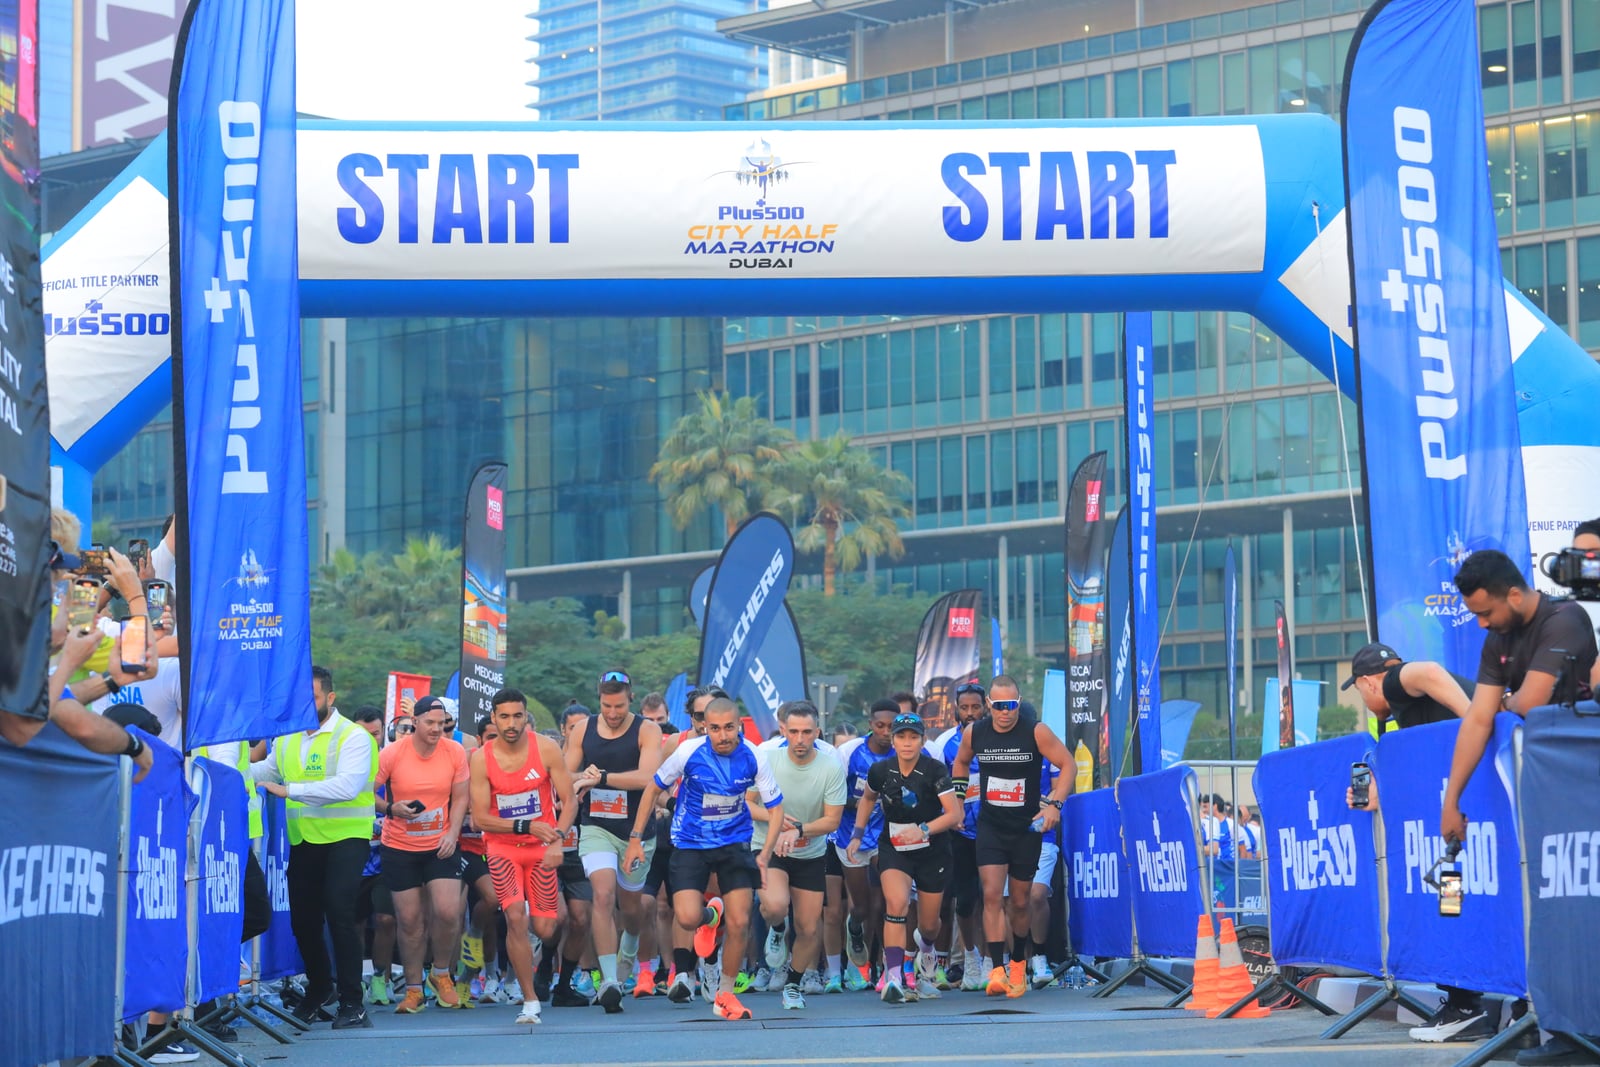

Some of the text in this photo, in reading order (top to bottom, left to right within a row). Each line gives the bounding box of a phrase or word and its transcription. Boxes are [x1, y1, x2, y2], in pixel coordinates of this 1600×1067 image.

[337, 154, 579, 244] START
[942, 150, 1176, 242] START
[718, 206, 804, 220] Plus500
[688, 224, 839, 240] CITY HALF
[684, 241, 835, 254] MARATHON
[729, 258, 793, 269] DUBAI
[81, 275, 107, 287] TITLE
[110, 274, 159, 287] PARTNER
[1394, 106, 1467, 480] Plus500
[44, 313, 169, 336] lus500
[231, 603, 274, 614] Plus500
[218, 617, 250, 629] CITY
[241, 641, 272, 650] DUBAI
[1135, 840, 1188, 892] Plus500
[1278, 824, 1357, 892] Plus500
[136, 836, 178, 919] Plus500
[205, 844, 240, 915] Plus500
